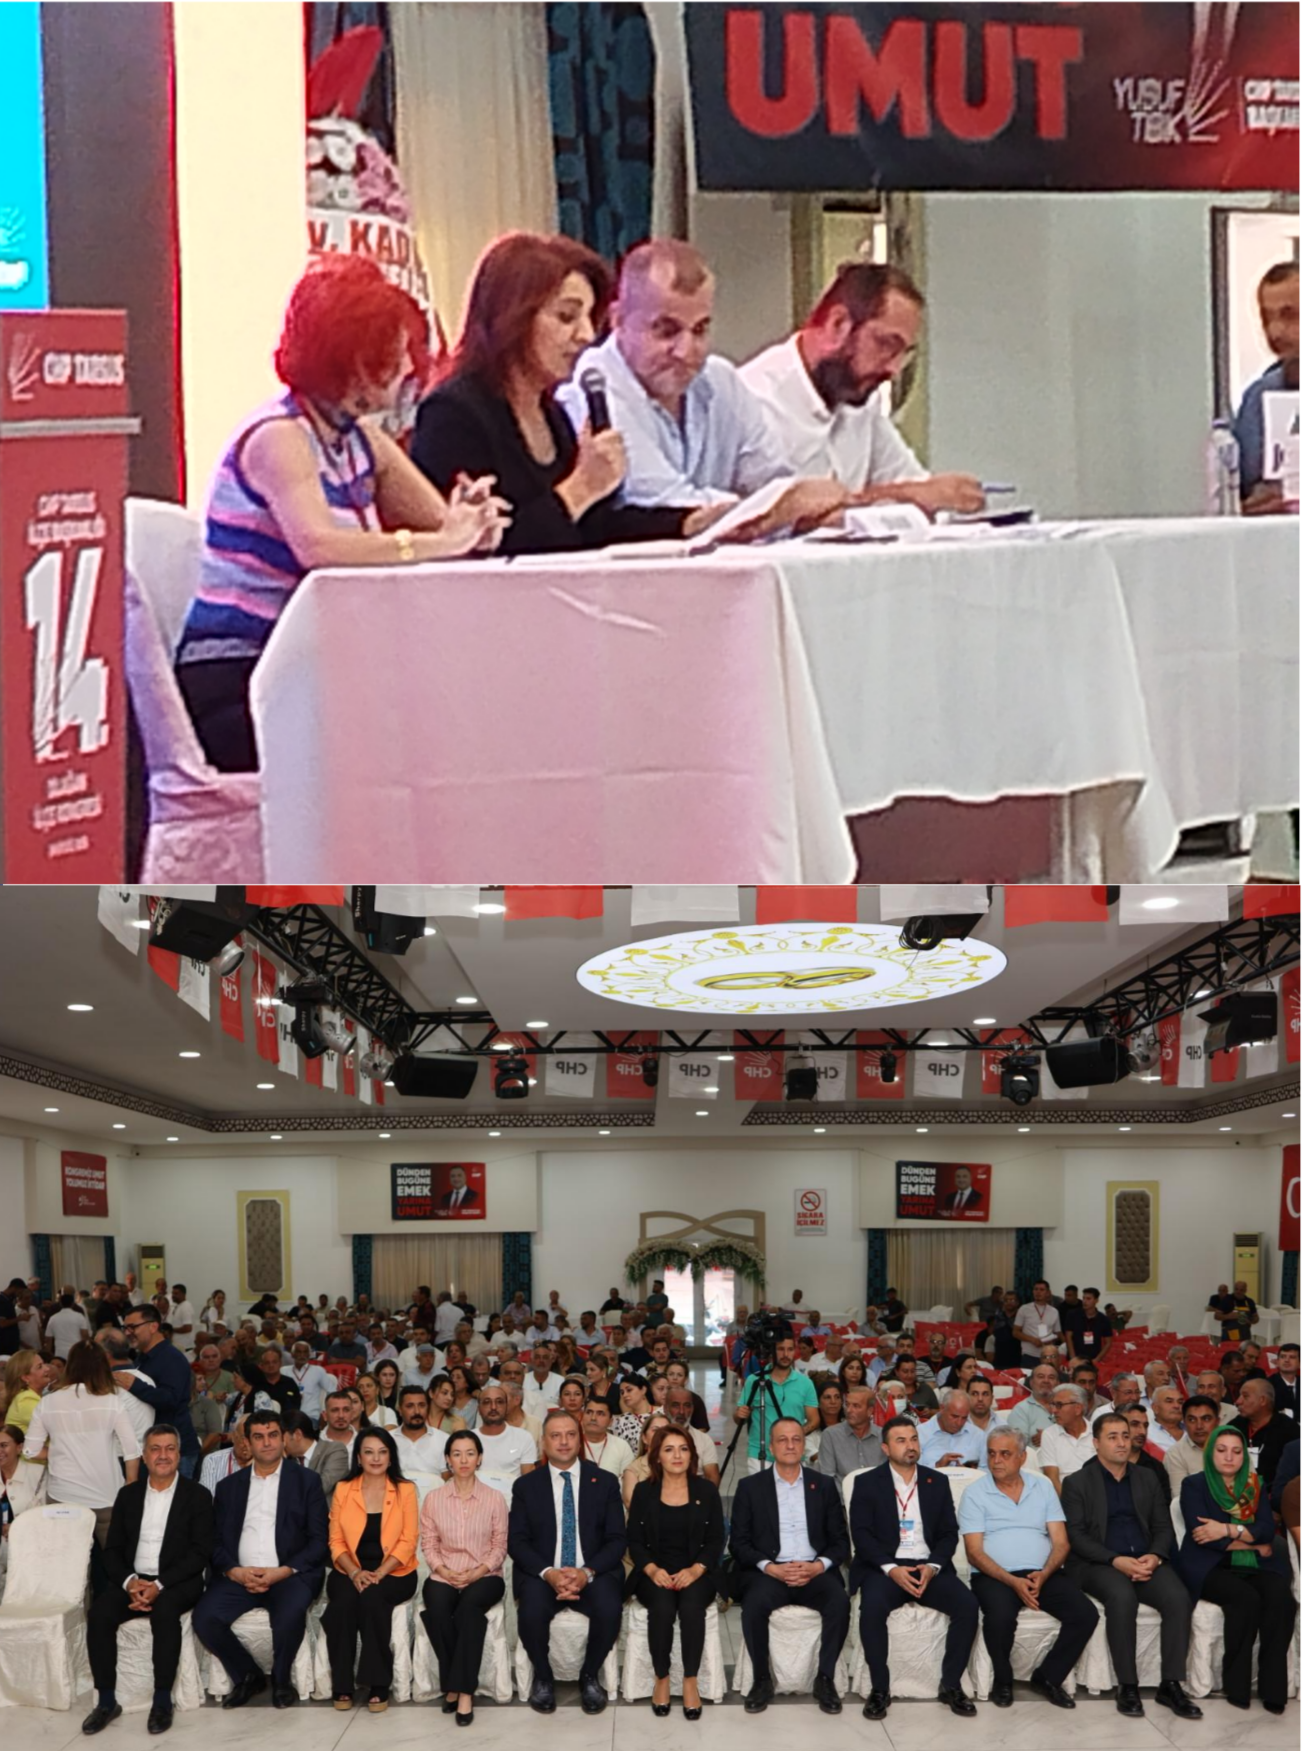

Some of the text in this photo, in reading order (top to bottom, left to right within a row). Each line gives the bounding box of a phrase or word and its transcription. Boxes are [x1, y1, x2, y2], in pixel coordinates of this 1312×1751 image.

[725, 9, 1083, 141] UMUT
[396, 1167, 431, 1176] DÜNDEN
[901, 1165, 936, 1175] DÜNDEN
[396, 1176, 431, 1185] BUGÜNE
[901, 1174, 936, 1183] BUGÜNE
[396, 1186, 431, 1196] EMEK
[900, 1184, 935, 1195] EMEK
[900, 1205, 935, 1216] UMUT
